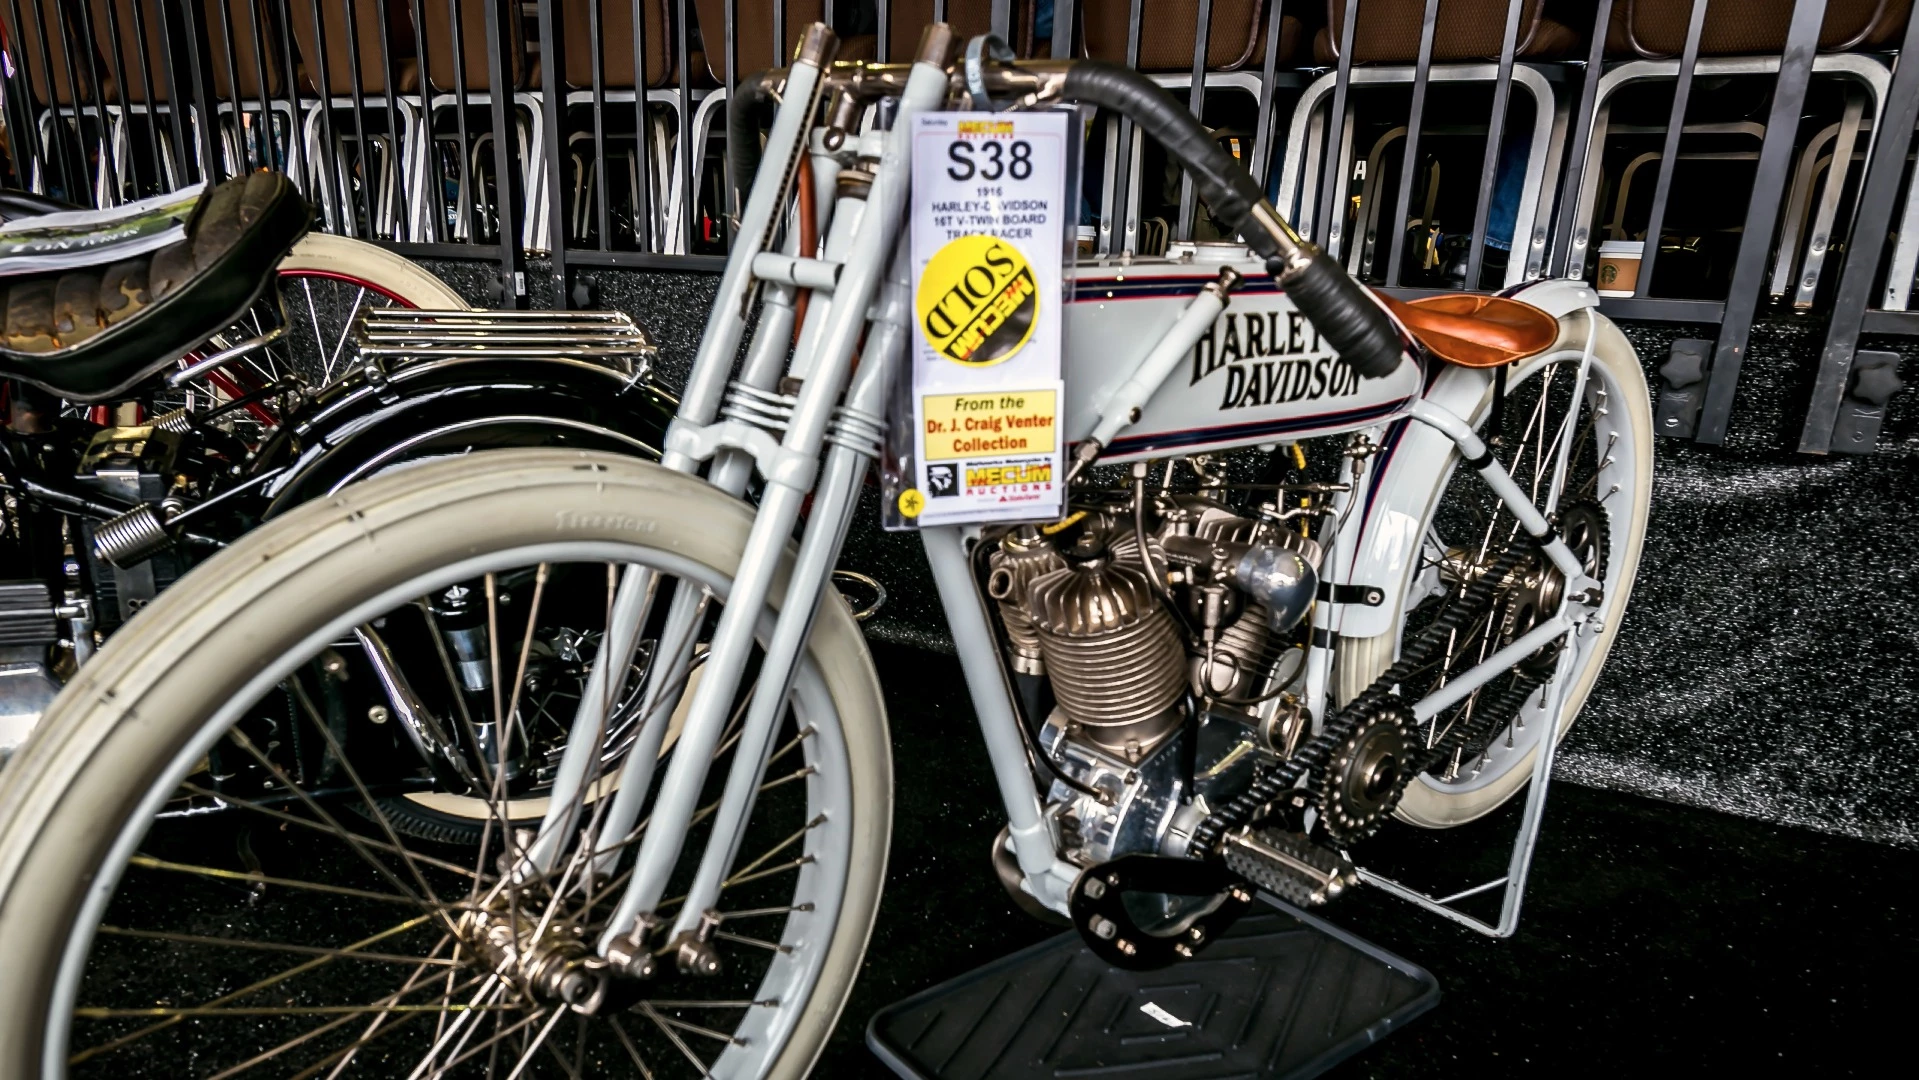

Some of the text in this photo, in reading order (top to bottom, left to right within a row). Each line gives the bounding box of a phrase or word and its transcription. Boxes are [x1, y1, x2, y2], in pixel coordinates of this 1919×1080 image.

[947, 140, 1033, 181] S38
[977, 186, 1003, 197] 1916
[931, 200, 1048, 212] HARLEY-DVIDSON
[1002, 214, 1047, 225] BOARD
[926, 243, 1014, 339] SOLD
[950, 274, 1034, 361] MECUM
[1218, 356, 1360, 410] DAVIDSON
[954, 396, 1025, 412] From the
[926, 414, 1054, 434] Dr. J. Craig Venter
[953, 436, 1027, 452] Collection
[966, 463, 1052, 488] MECUM
[966, 483, 1052, 496] AUCTIONS
